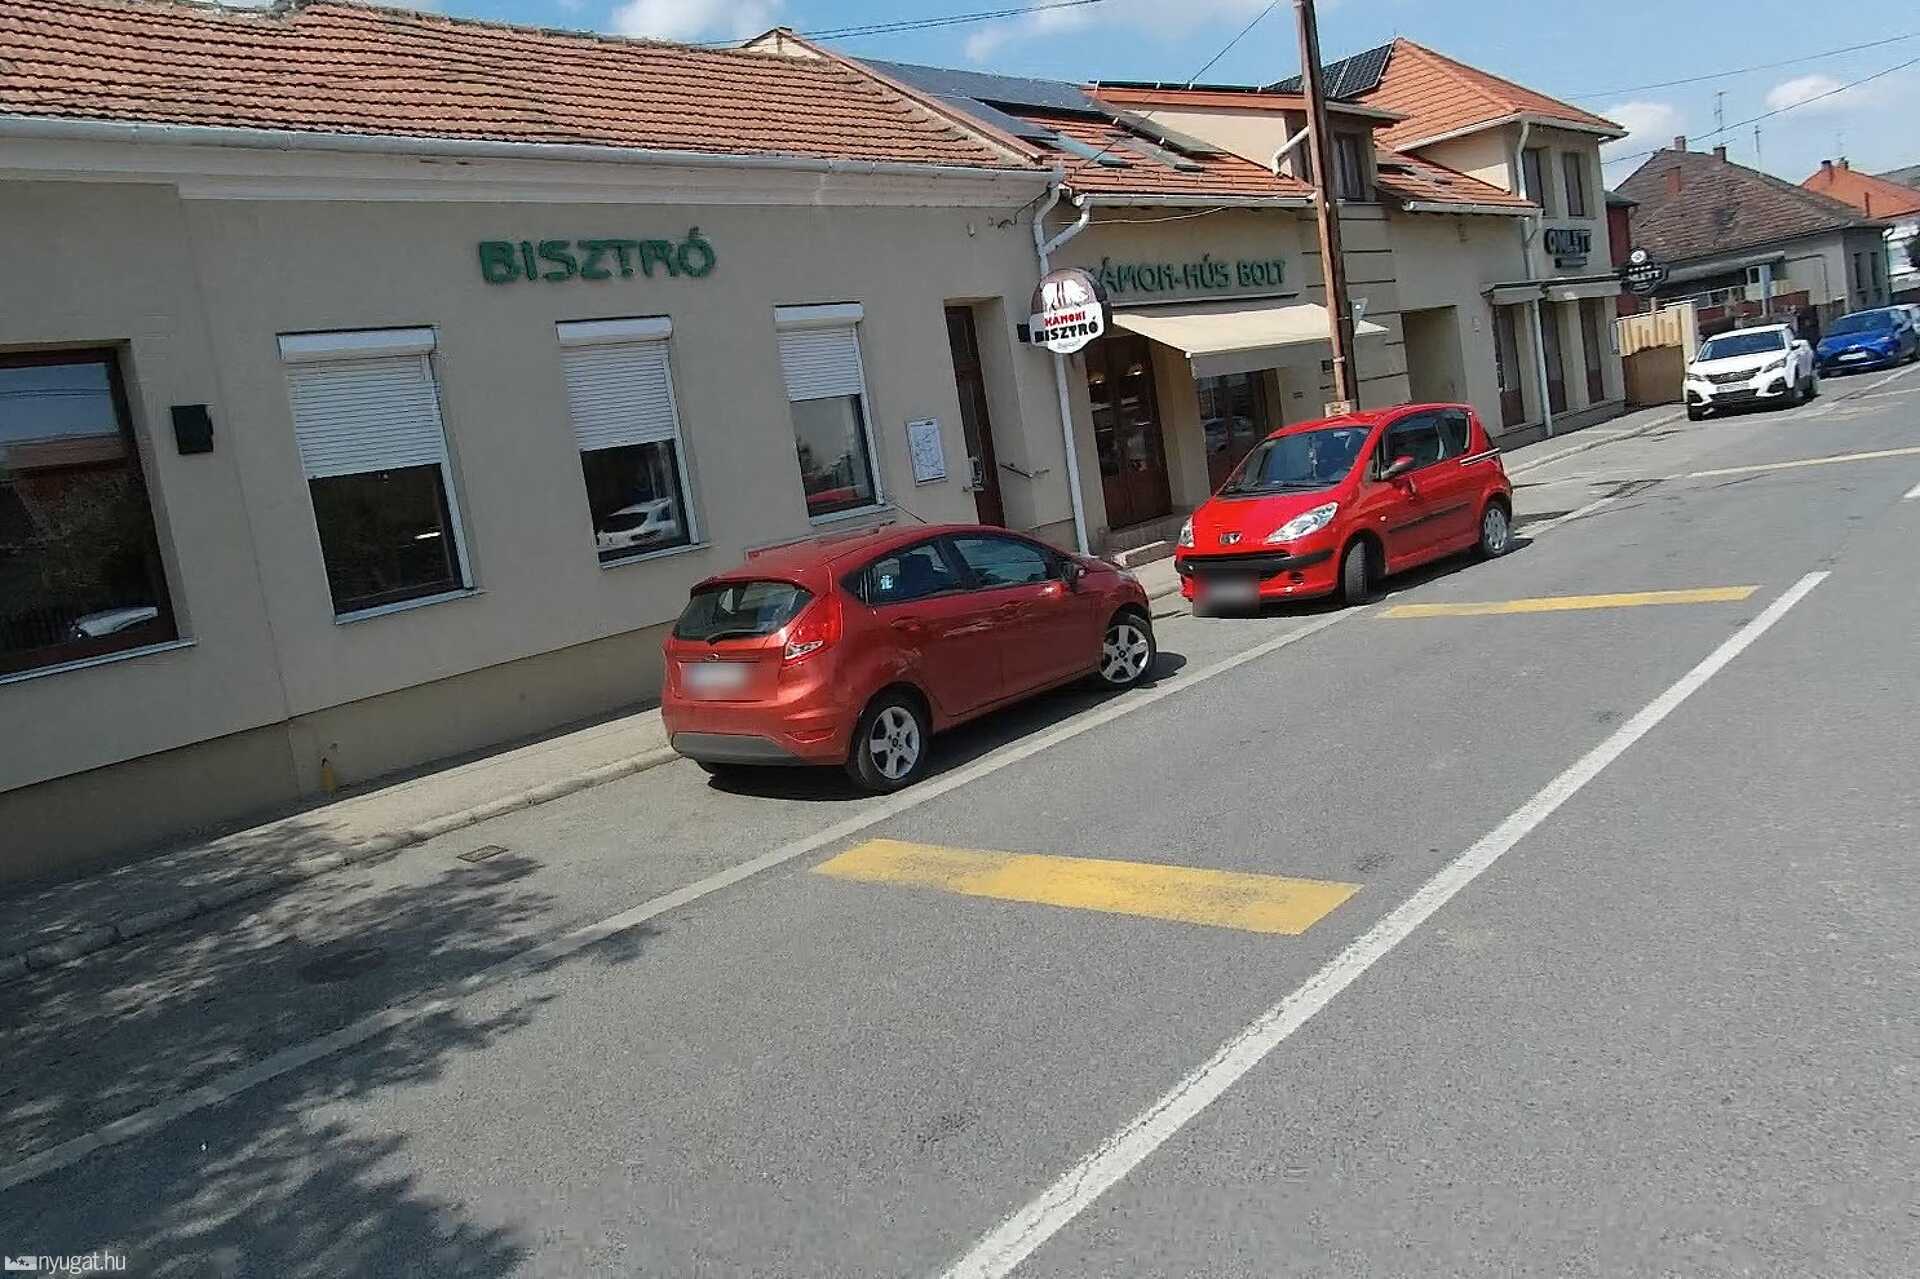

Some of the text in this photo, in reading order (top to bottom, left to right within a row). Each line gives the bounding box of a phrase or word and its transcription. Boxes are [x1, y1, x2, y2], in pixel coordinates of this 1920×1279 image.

[479, 225, 716, 285] BISZTRÓ
[1236, 259, 1285, 288] BOLT
[1034, 316, 1099, 343] BISZTRÓ
